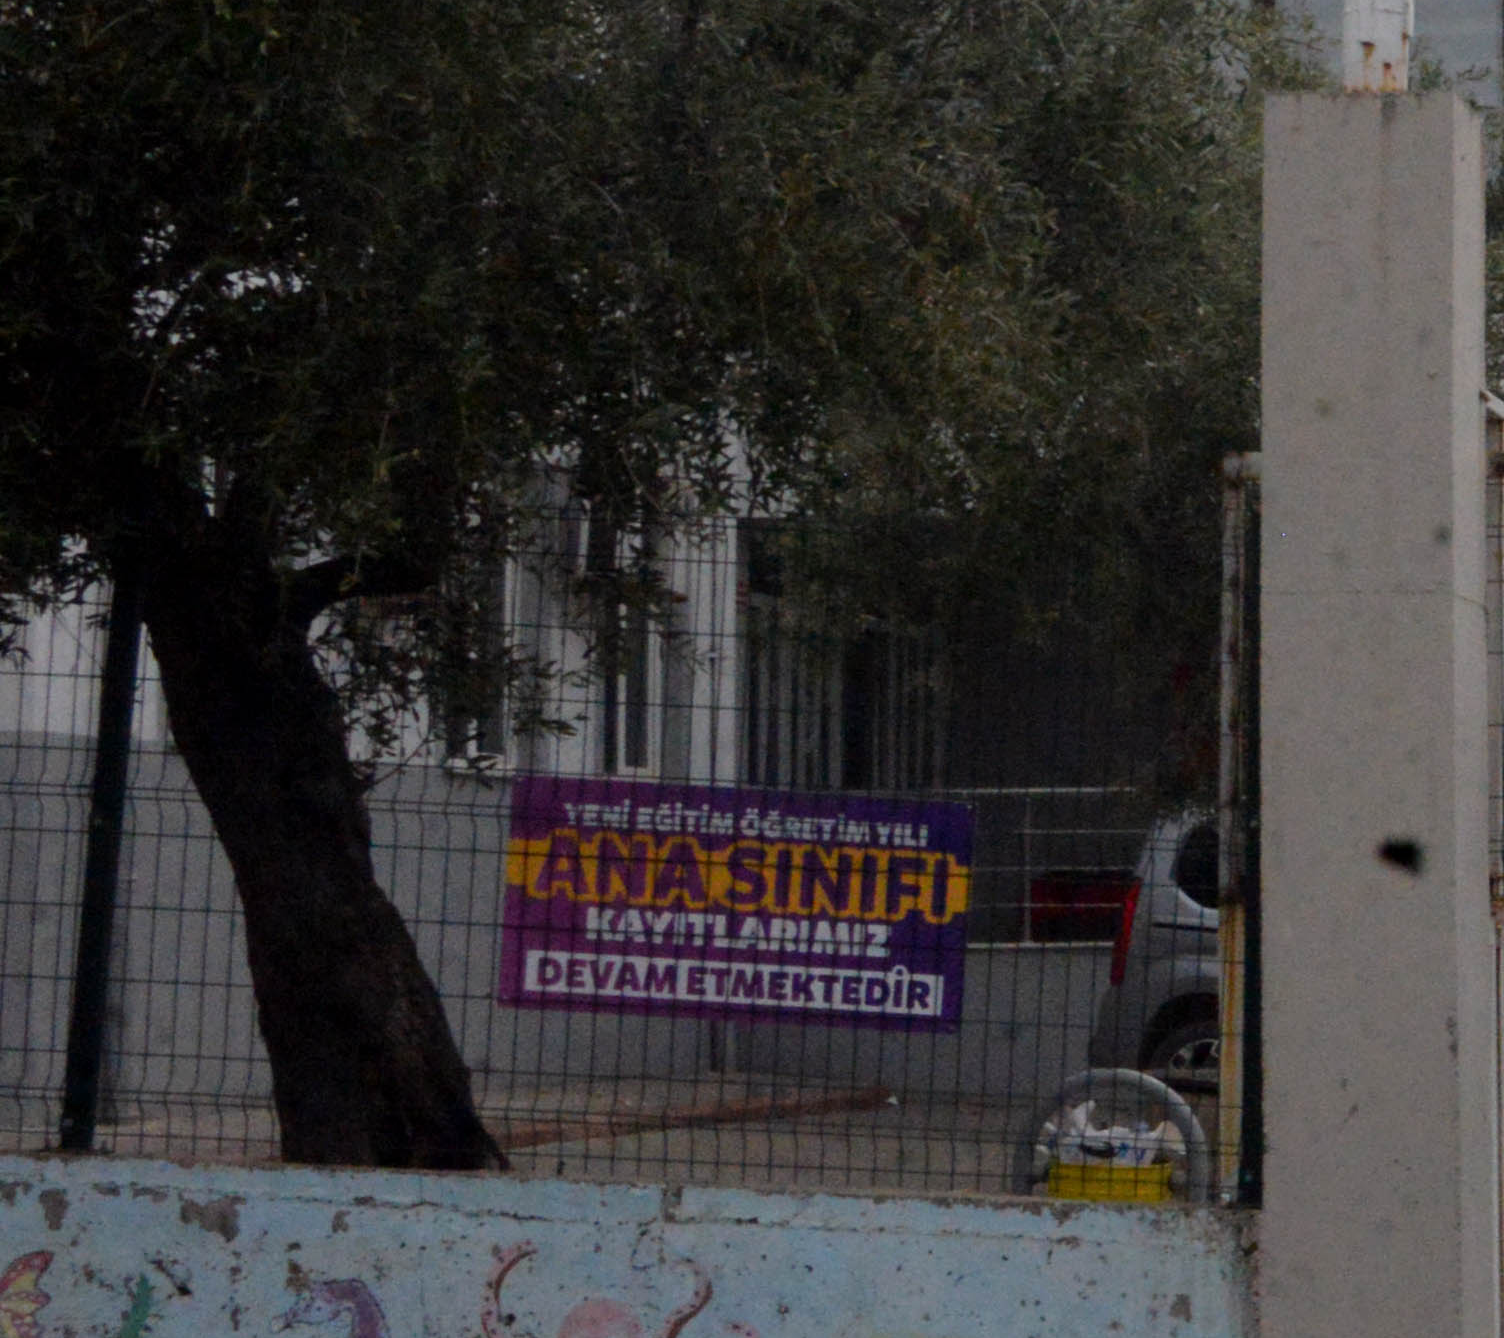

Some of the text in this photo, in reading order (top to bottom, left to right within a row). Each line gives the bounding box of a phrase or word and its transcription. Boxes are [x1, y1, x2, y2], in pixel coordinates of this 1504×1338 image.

[564, 799, 929, 847] YENİ EĞİTİM ÖĞRETİM YILI
[533, 833, 949, 920] ANA SINIFI
[586, 907, 892, 957] KAYITLARIMIZ
[536, 957, 931, 1011] DEVAM ETMEKTEDİR
